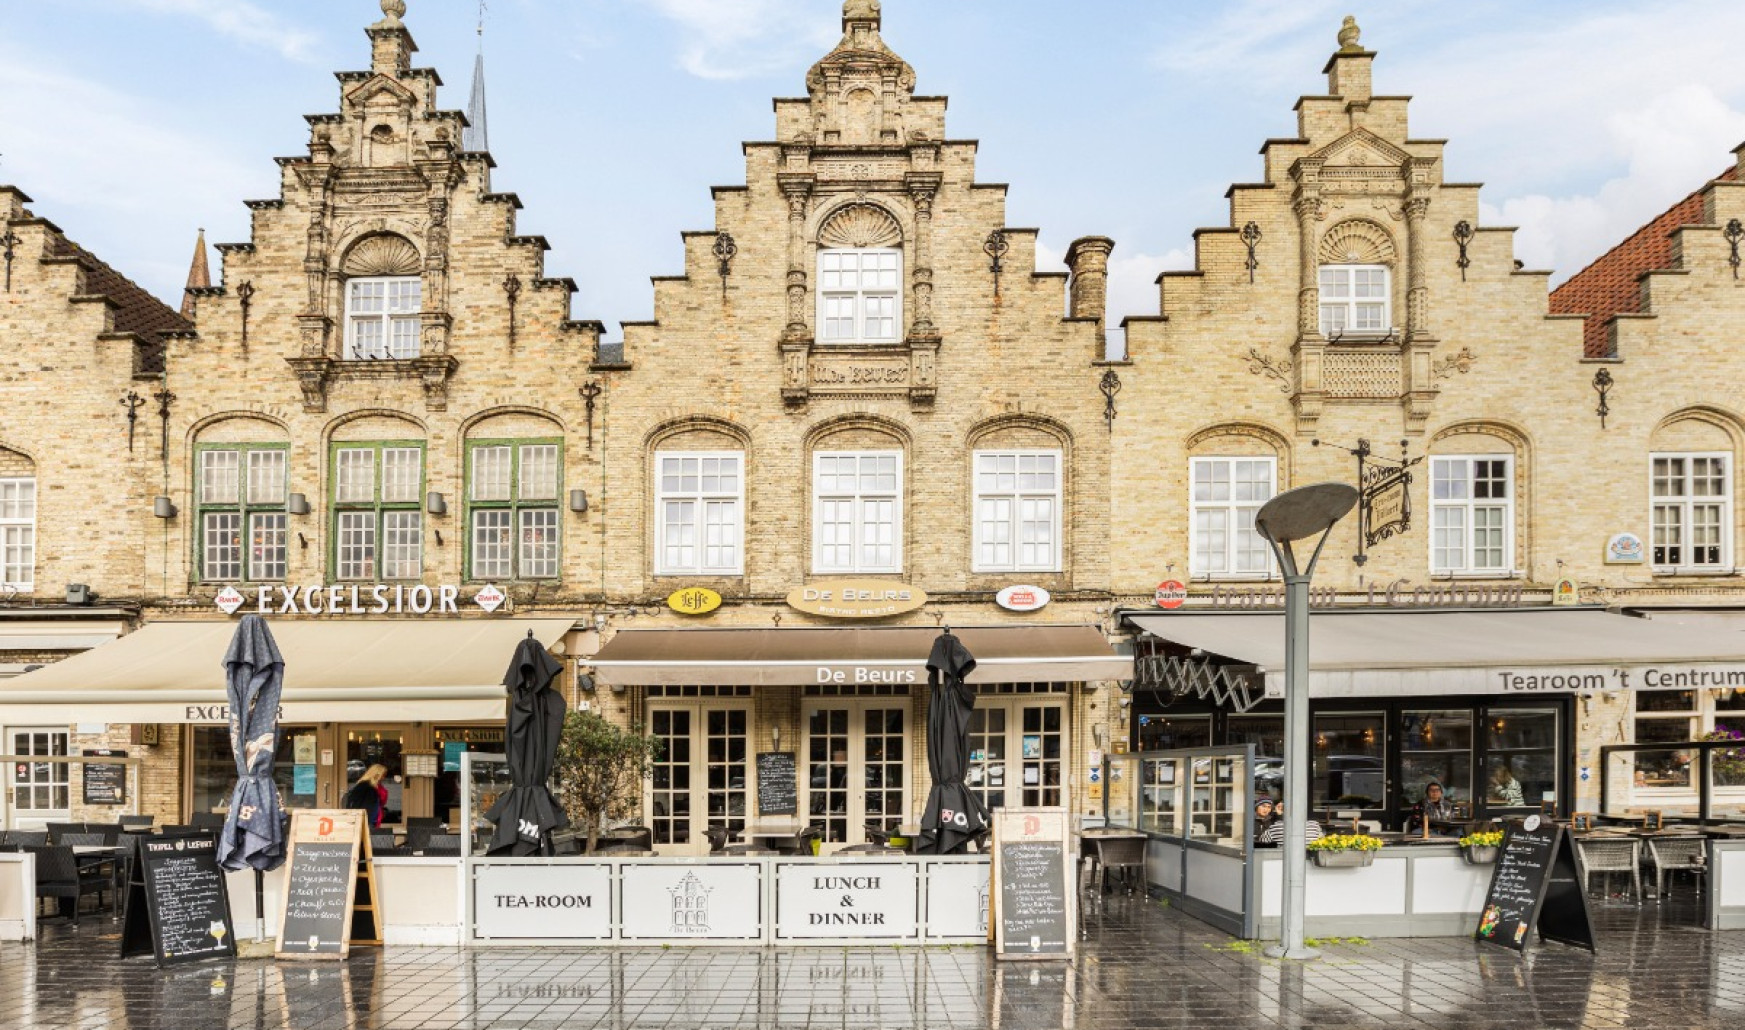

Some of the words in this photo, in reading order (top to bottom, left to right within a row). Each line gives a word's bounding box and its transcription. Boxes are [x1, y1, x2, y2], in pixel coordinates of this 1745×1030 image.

[258, 585, 459, 614] EXCELSIOR
[816, 667, 846, 683] De
[854, 667, 916, 683] Beurs
[1499, 671, 1605, 690] Tearoom
[1612, 669, 1630, 688] 't
[1644, 667, 1745, 688] Centrum
[813, 876, 882, 890] LUNCH
[494, 894, 592, 909] TEA-ROOM
[839, 894, 855, 907] &
[809, 913, 885, 925] DINNER
